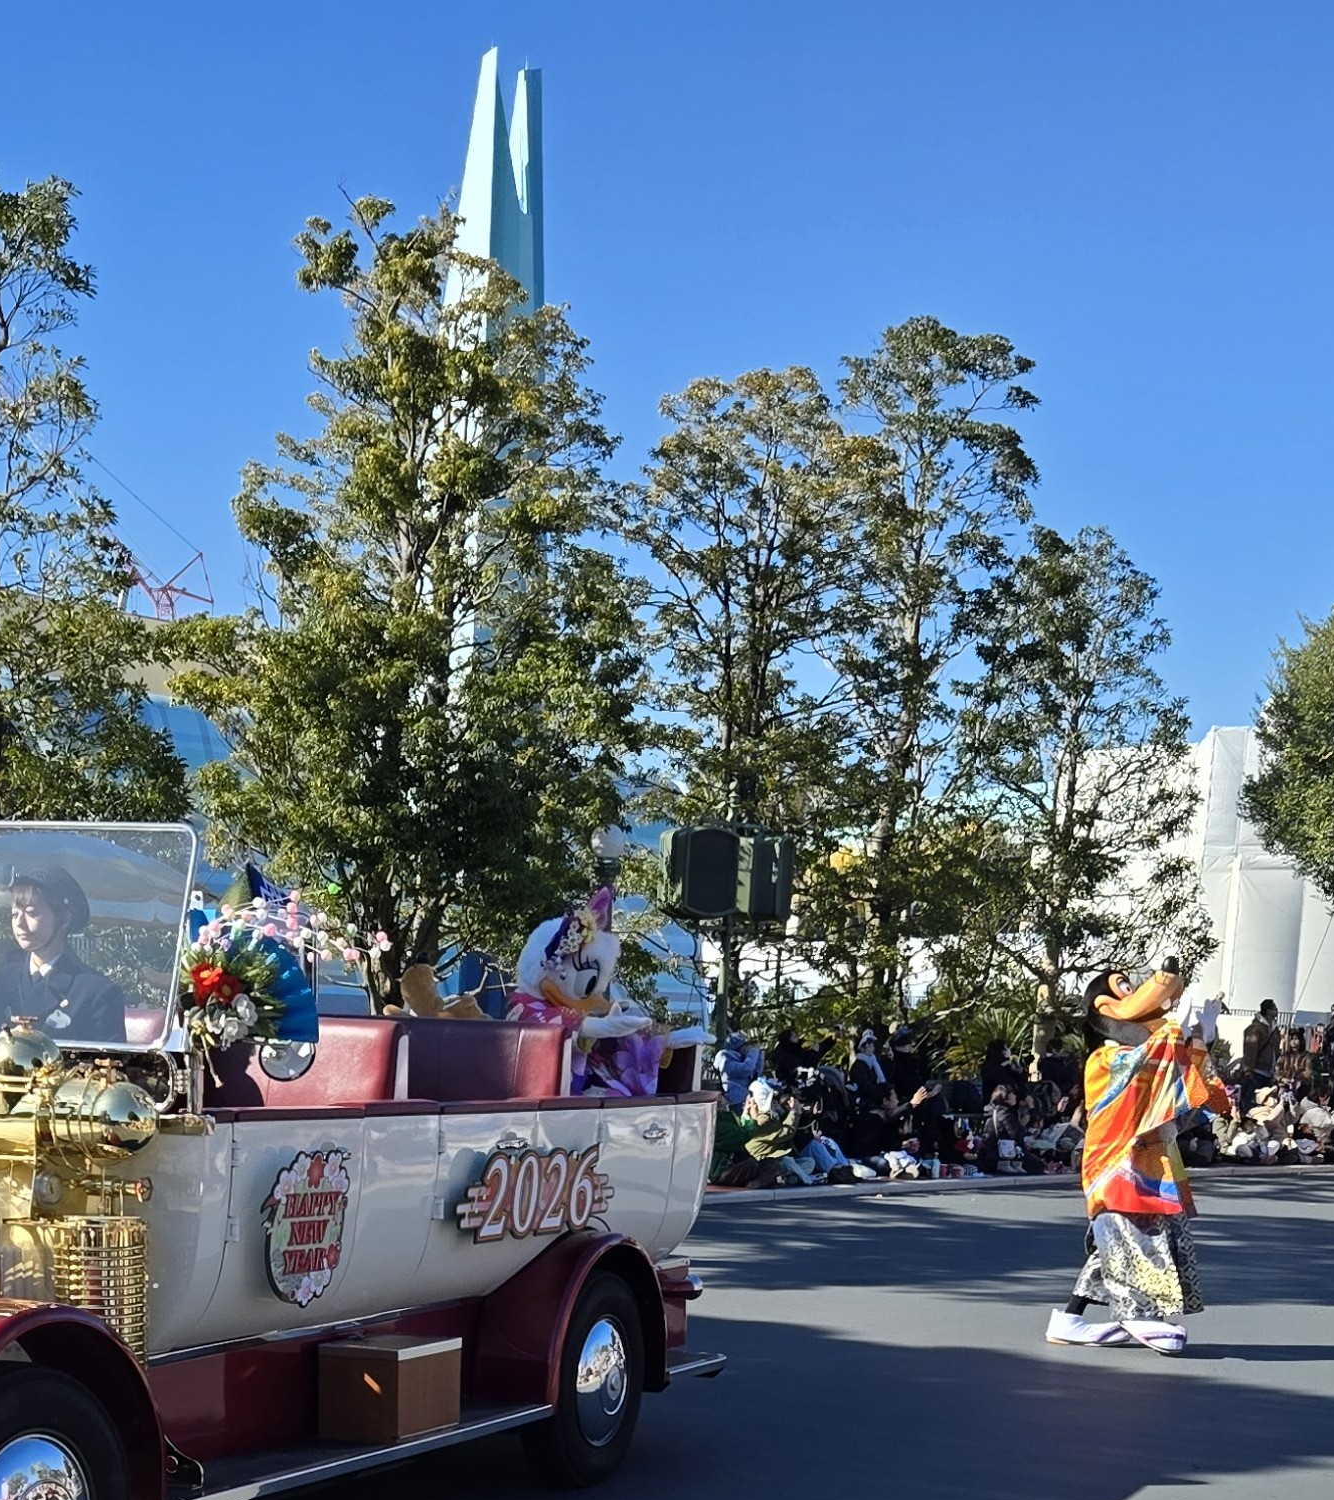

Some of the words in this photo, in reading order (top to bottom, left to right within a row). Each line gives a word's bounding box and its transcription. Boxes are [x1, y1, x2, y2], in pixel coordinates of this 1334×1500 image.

[283, 1191, 342, 1219] HAPPY
[478, 1149, 600, 1238] 2026
[287, 1220, 330, 1247] NEW
[282, 1248, 329, 1275] YEAR
